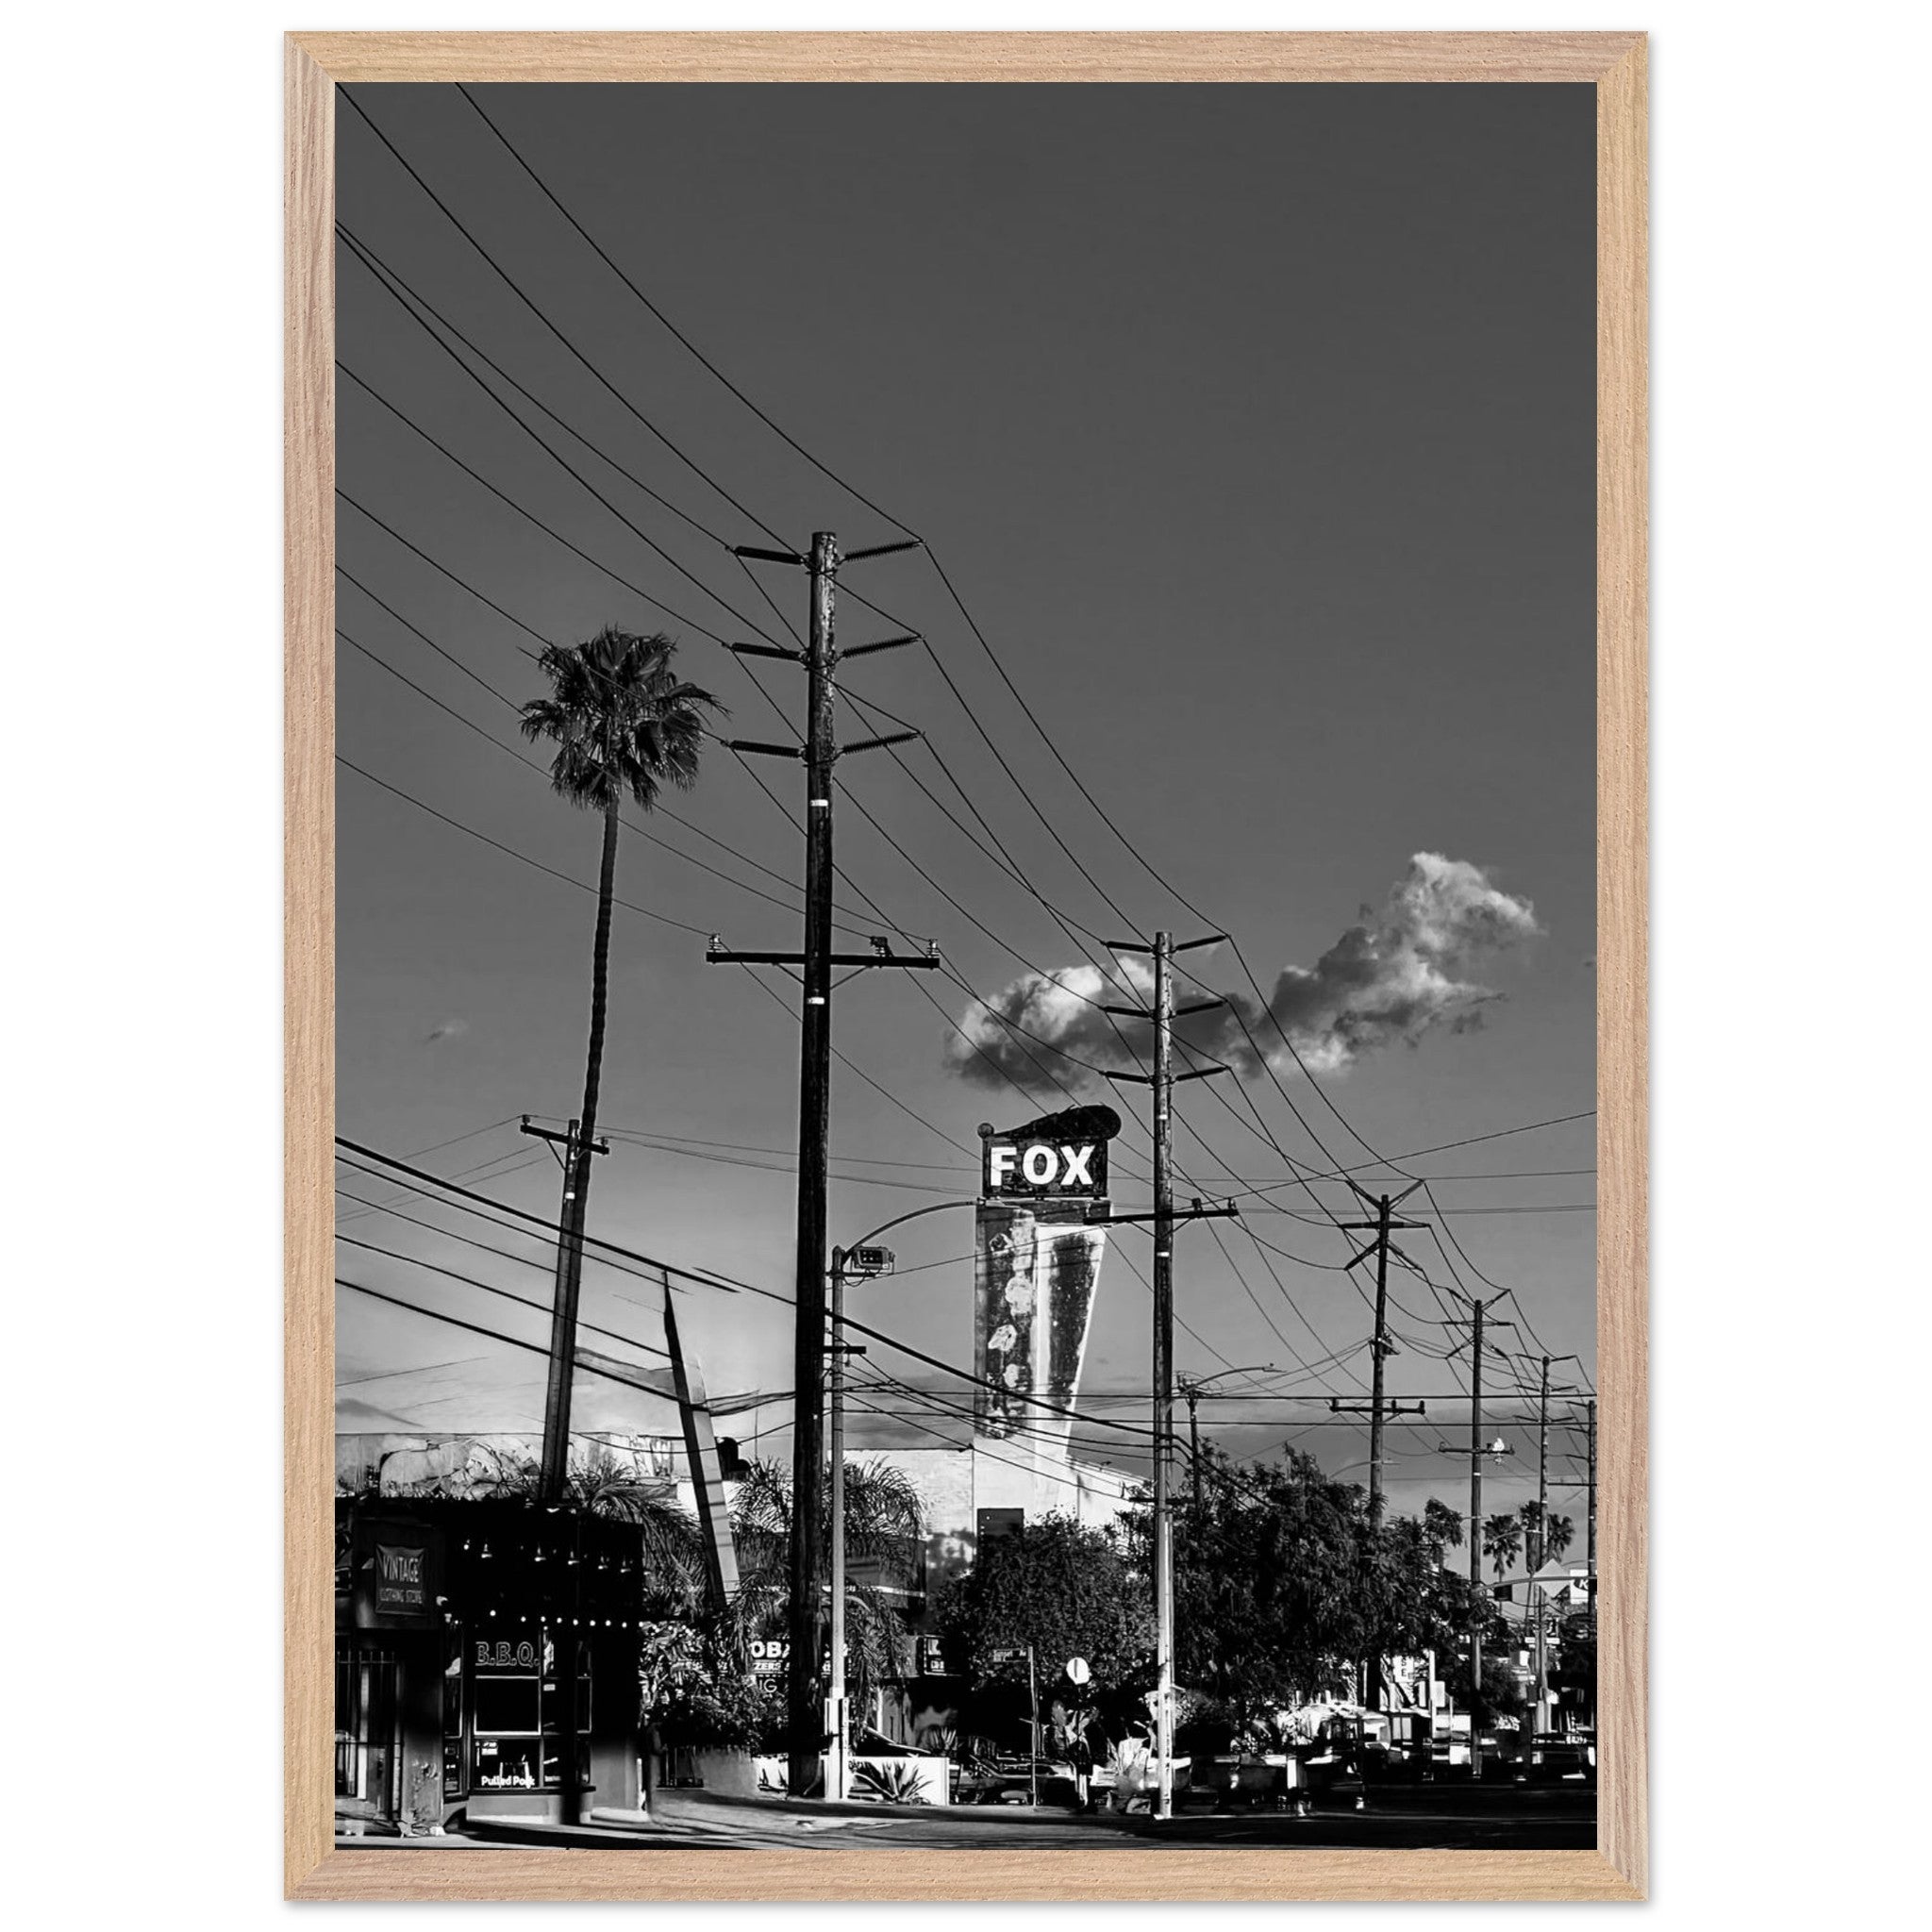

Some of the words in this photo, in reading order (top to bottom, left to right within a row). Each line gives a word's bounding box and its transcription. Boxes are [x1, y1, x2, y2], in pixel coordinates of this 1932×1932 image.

[991, 1144, 1095, 1187] FOX
[383, 1555, 419, 1583] VINTAGE
[475, 1641, 540, 1668] B.B.Q.
